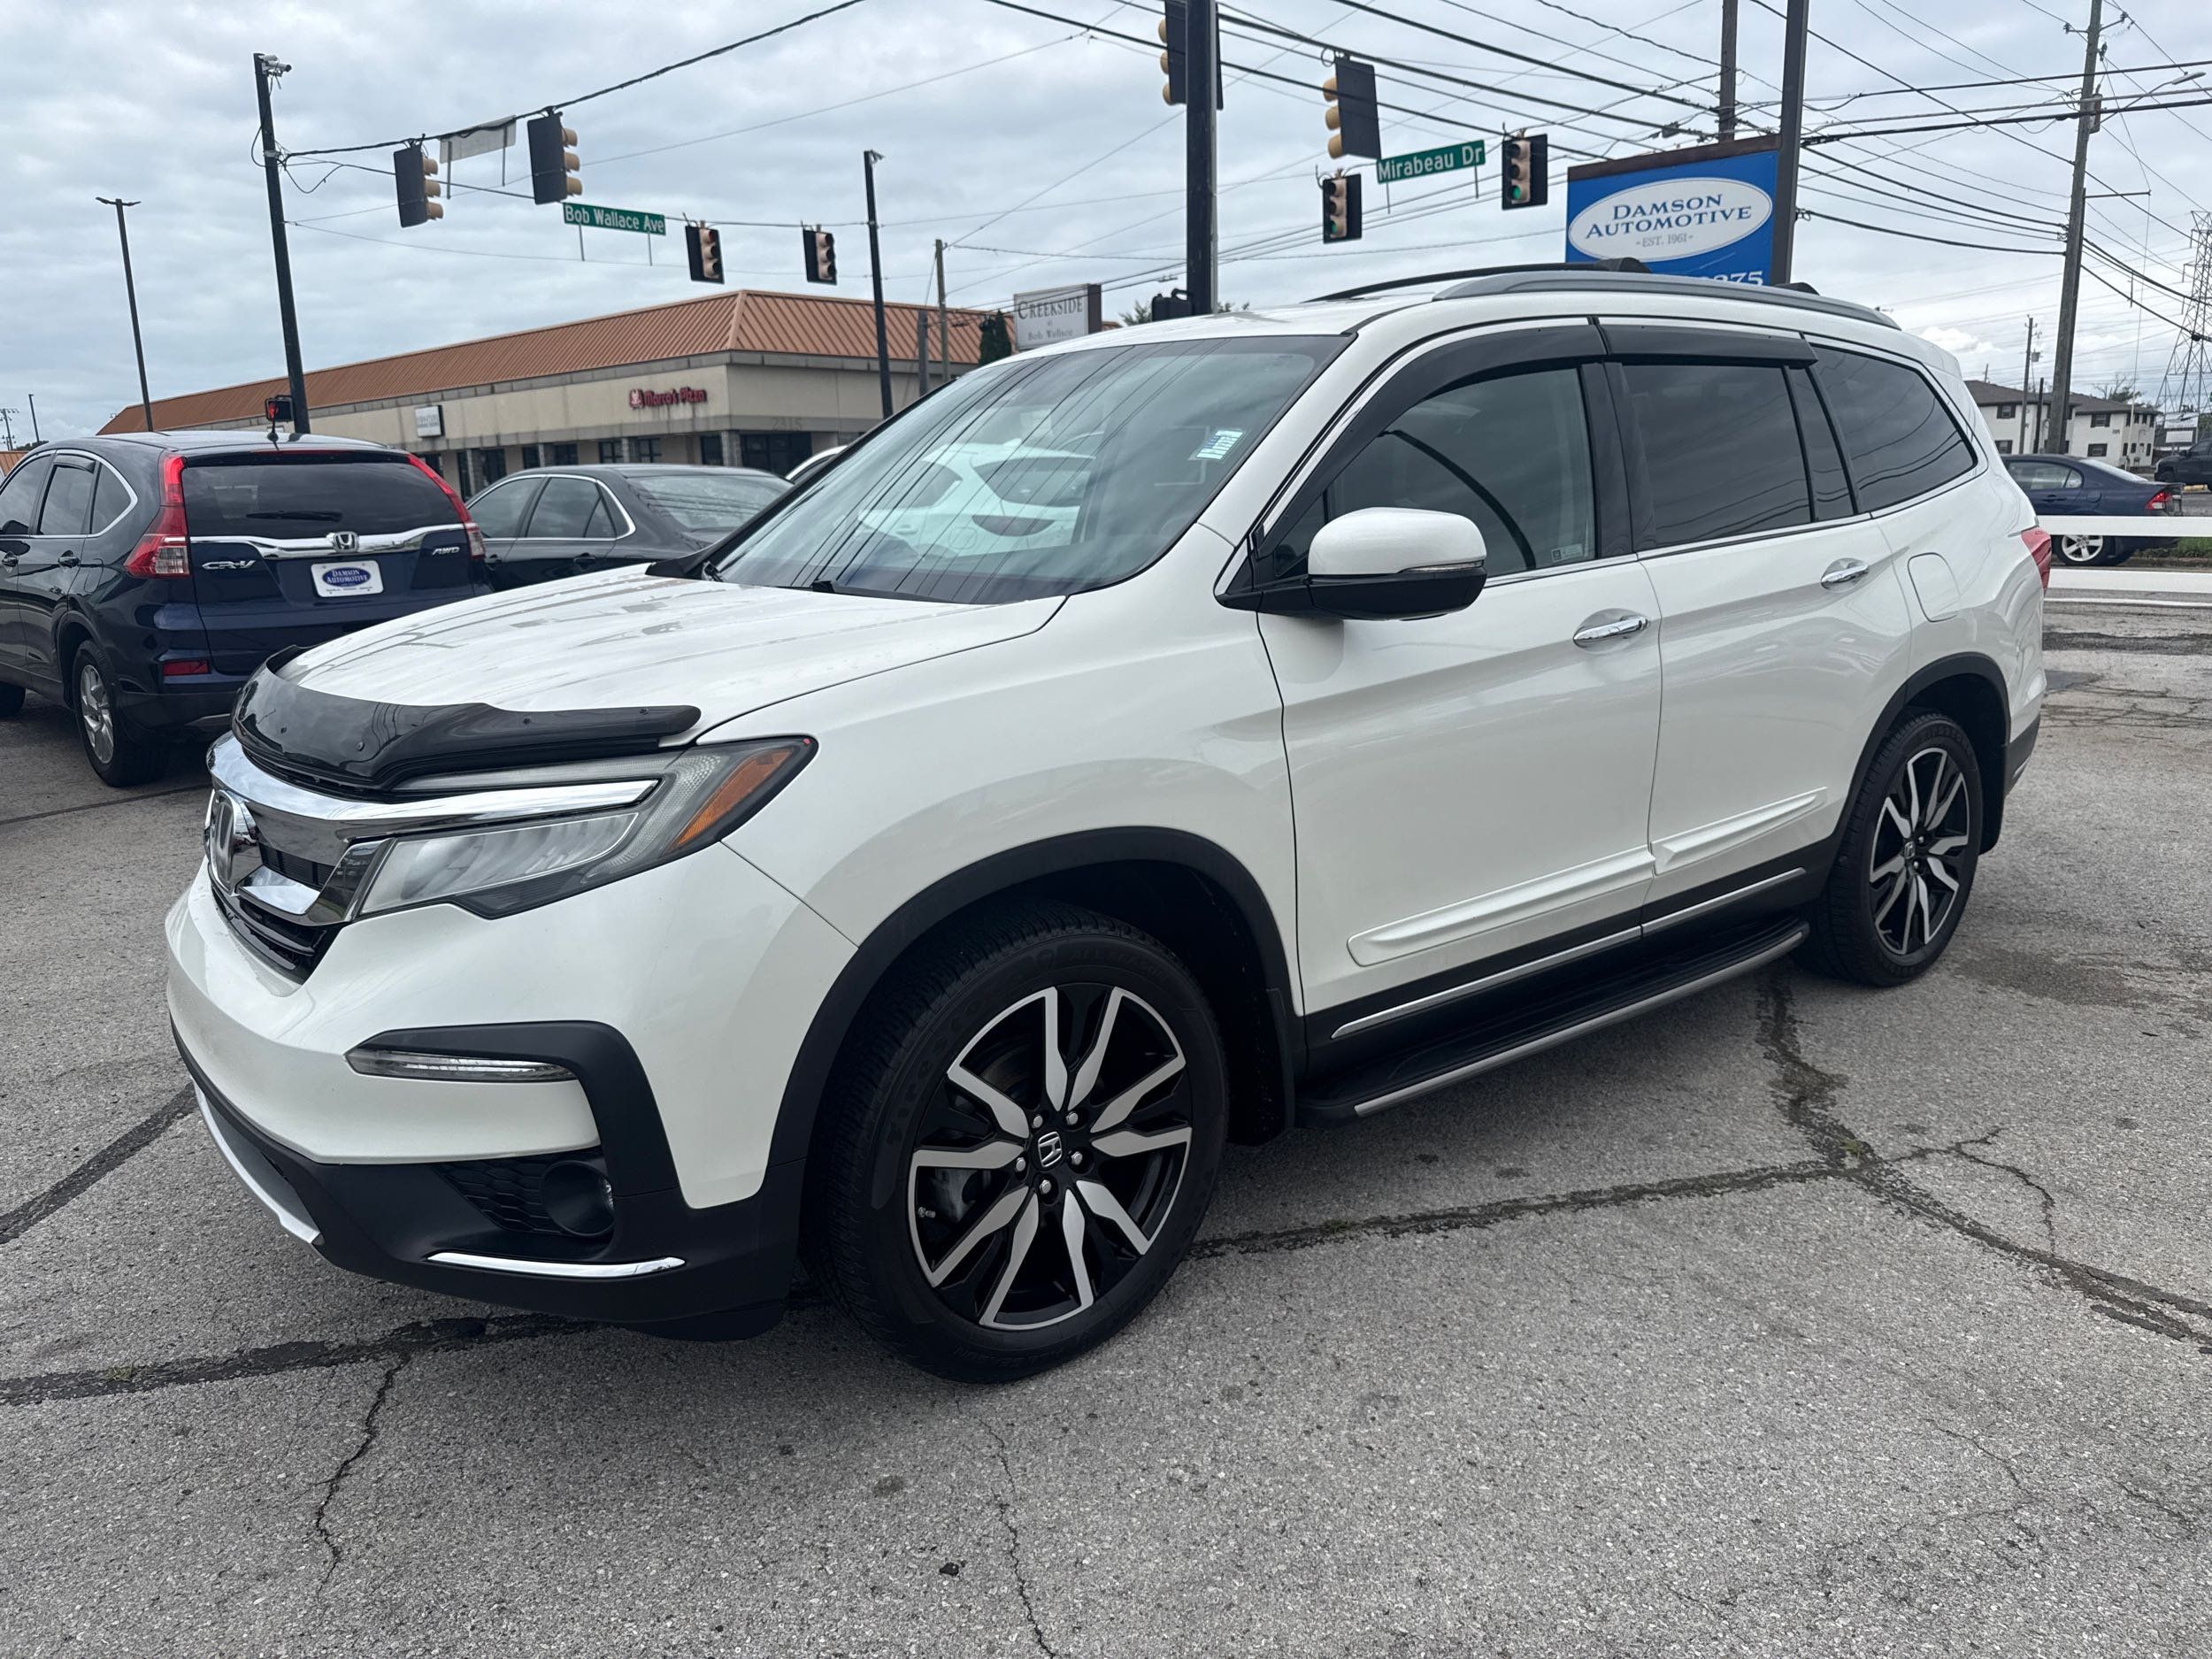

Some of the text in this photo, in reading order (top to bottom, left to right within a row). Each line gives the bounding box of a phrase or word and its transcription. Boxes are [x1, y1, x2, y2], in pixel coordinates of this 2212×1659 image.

[1379, 146, 1483, 180] Mirabeau Dr
[1614, 194, 1723, 220] DAMSON
[565, 204, 664, 233] Bob Wallace Ave
[1586, 206, 1752, 239] AUTOMOTIVE
[1018, 298, 1083, 319] CREEKSIDE
[644, 387, 707, 406] Marco's Pizza
[432, 546, 460, 555] AWD
[202, 560, 256, 569] CR-V
[326, 575, 368, 584] AUTOMOTIVE
